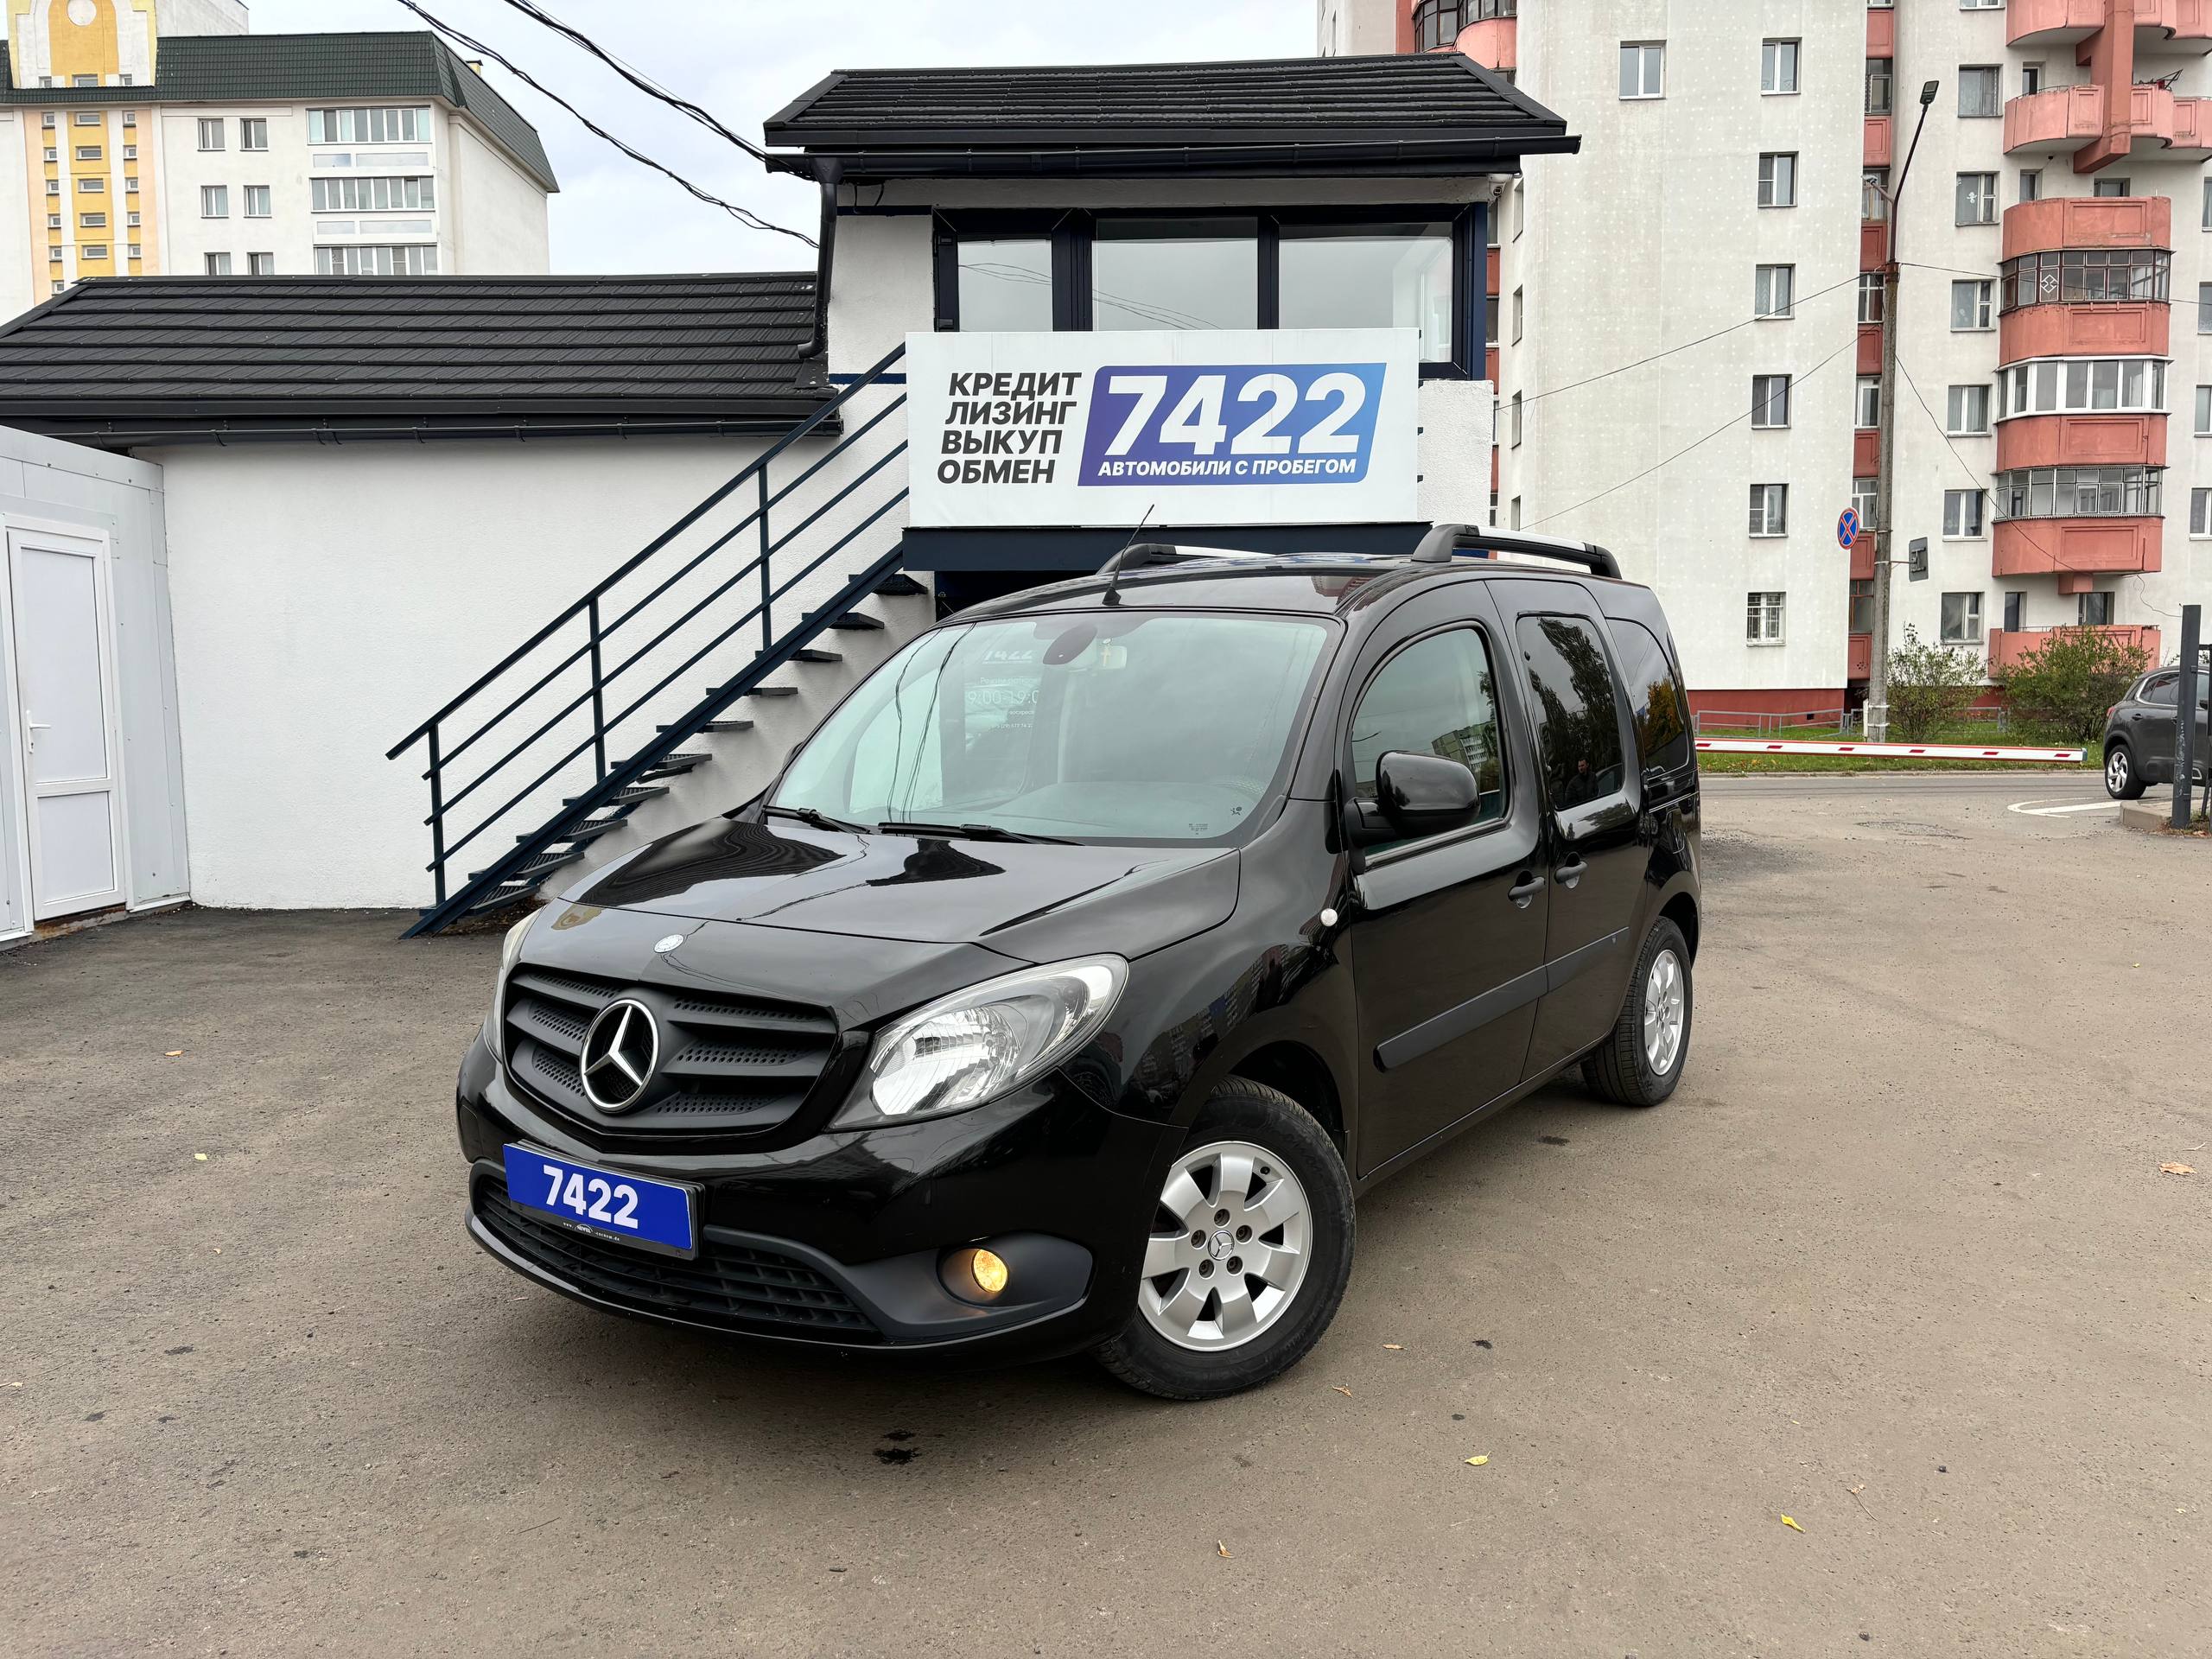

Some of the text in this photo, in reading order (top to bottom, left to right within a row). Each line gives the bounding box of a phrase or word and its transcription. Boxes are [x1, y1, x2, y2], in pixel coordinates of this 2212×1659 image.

[949, 372, 1082, 401] КРЕДИТ
[945, 401, 1077, 424] ЛИЗИНГ
[1103, 372, 1367, 456] 7422
[940, 430, 1063, 454] ВЫКУП
[937, 459, 1056, 484] ОБМЕН
[1097, 458, 1357, 477] АВТОМОБИЛИ С ПРОБЕГОМ
[543, 1164, 639, 1230] 7422
